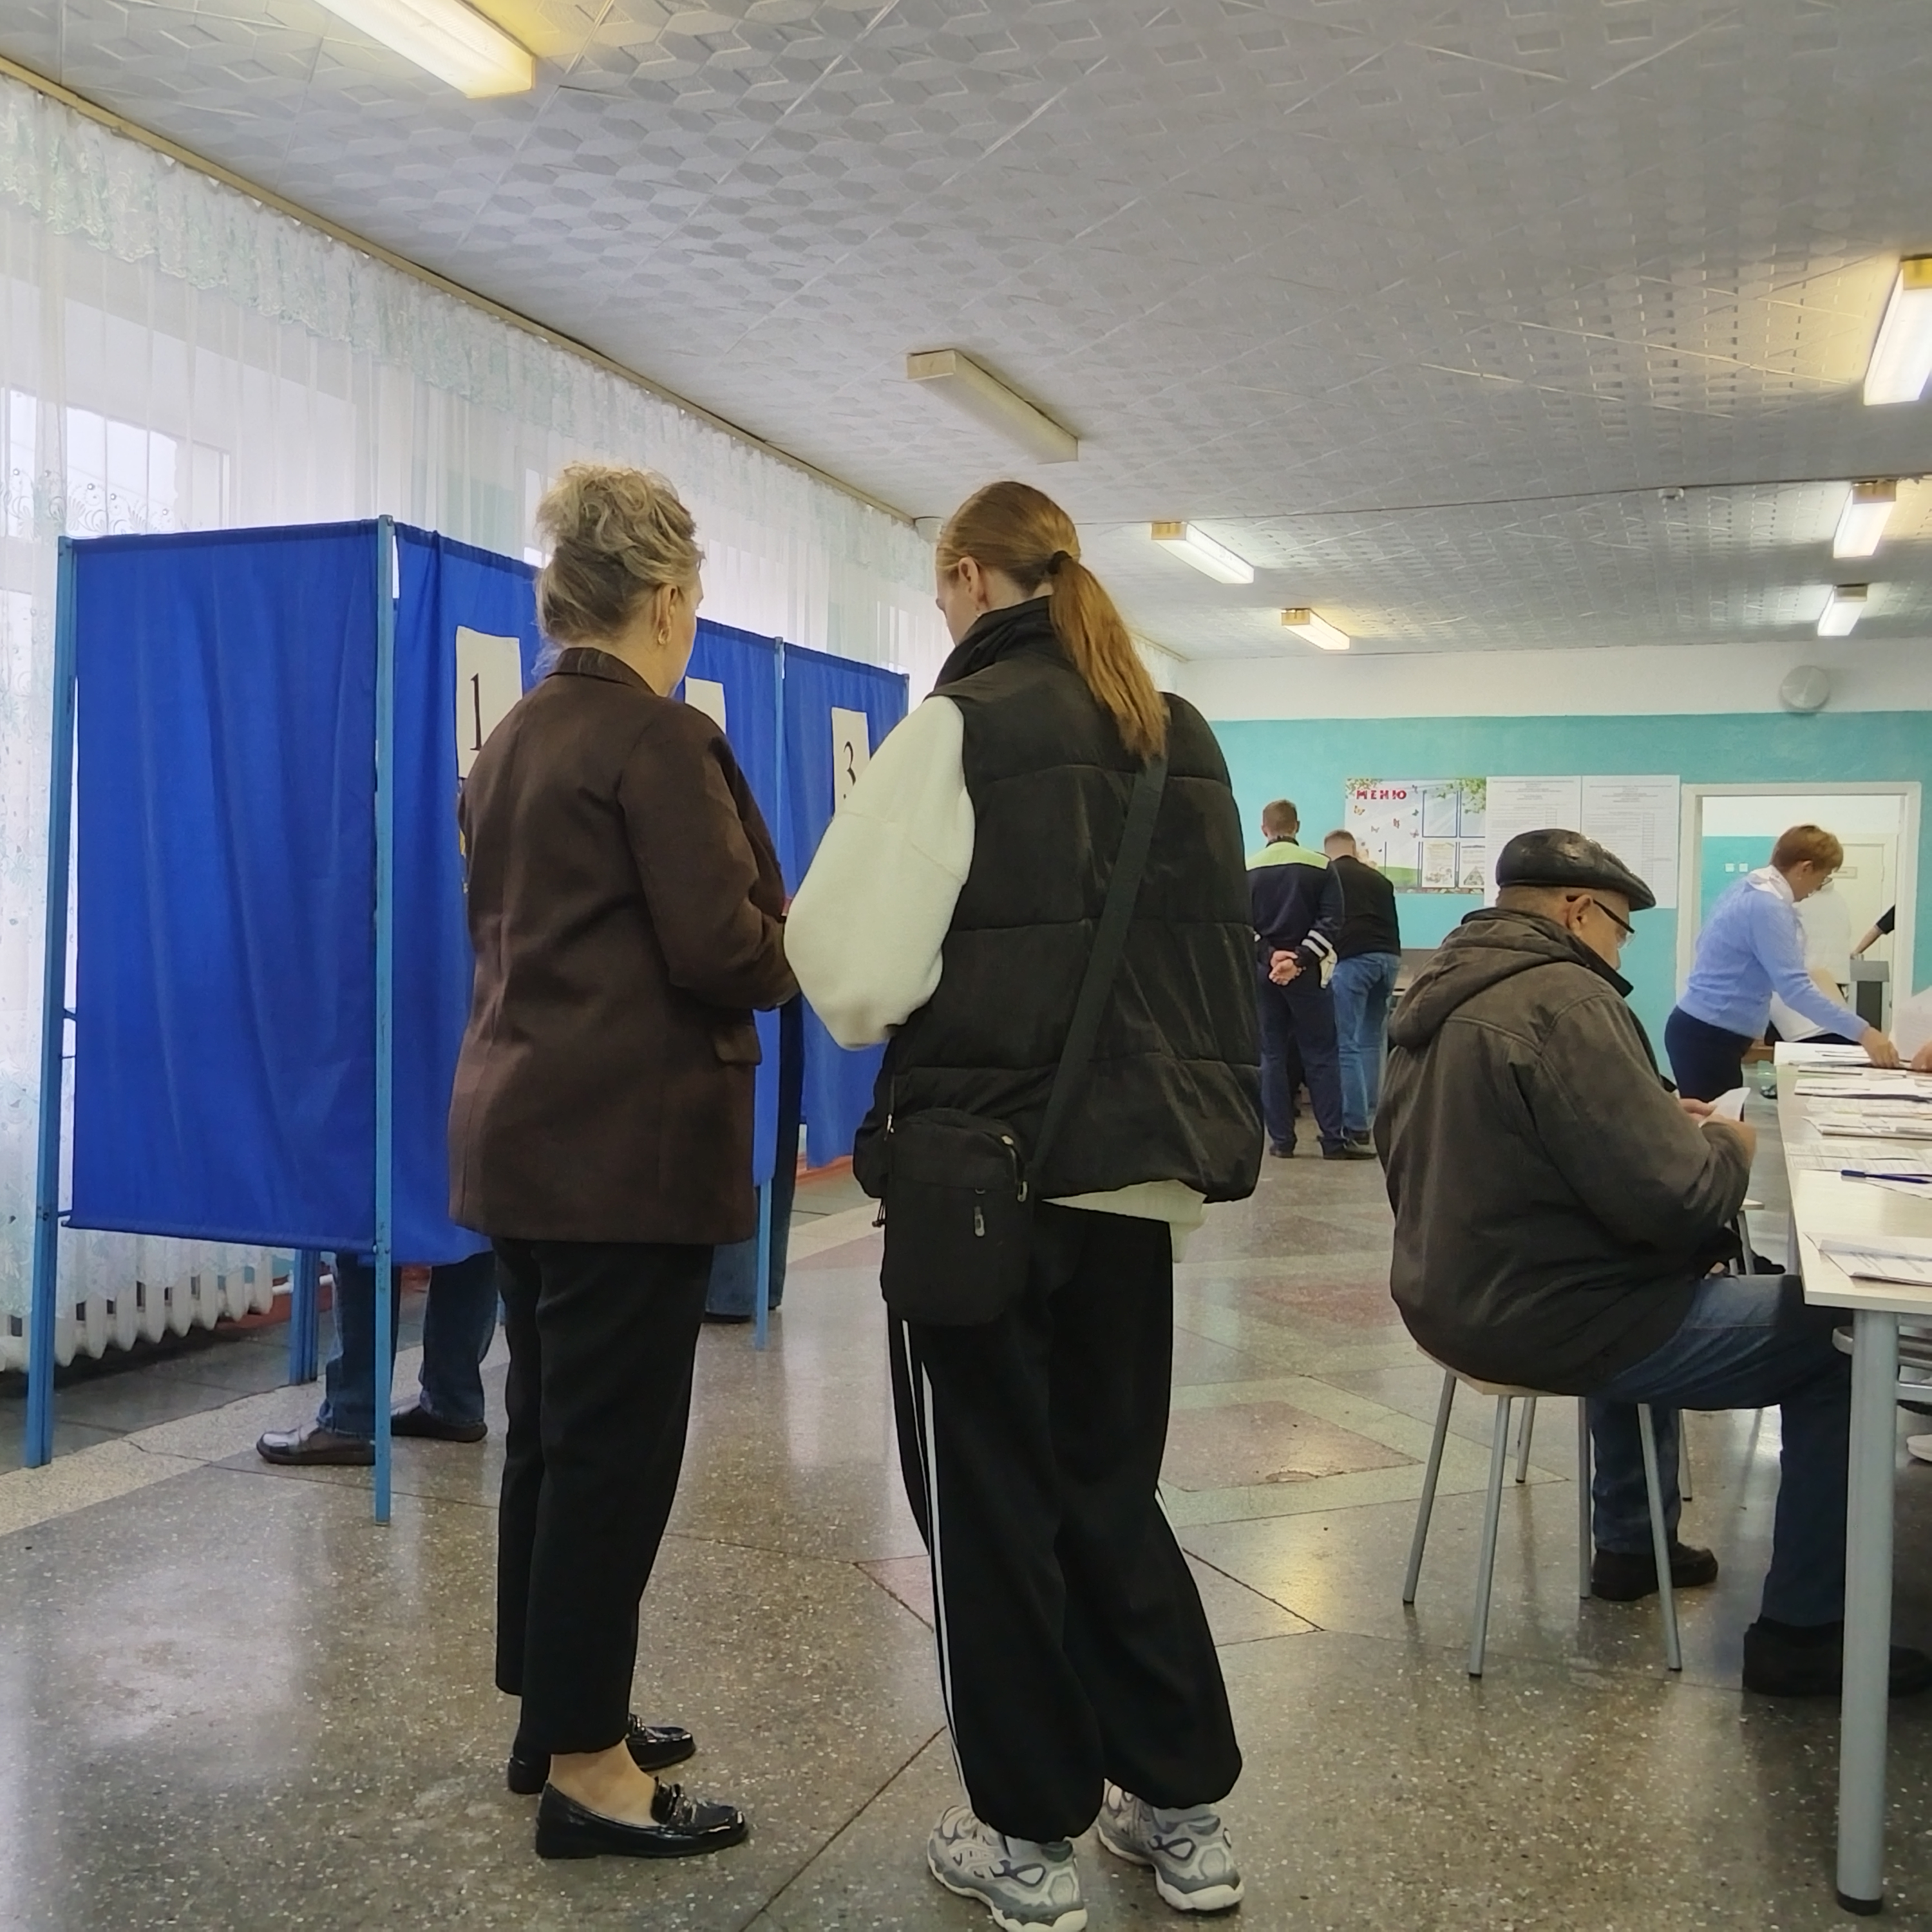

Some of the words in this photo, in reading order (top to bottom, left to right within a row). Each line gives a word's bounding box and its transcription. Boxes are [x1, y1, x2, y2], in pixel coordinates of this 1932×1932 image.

[469, 673, 482, 752] 1
[843, 741, 857, 800] 3
[1356, 790, 1407, 800] МЕНЮ
